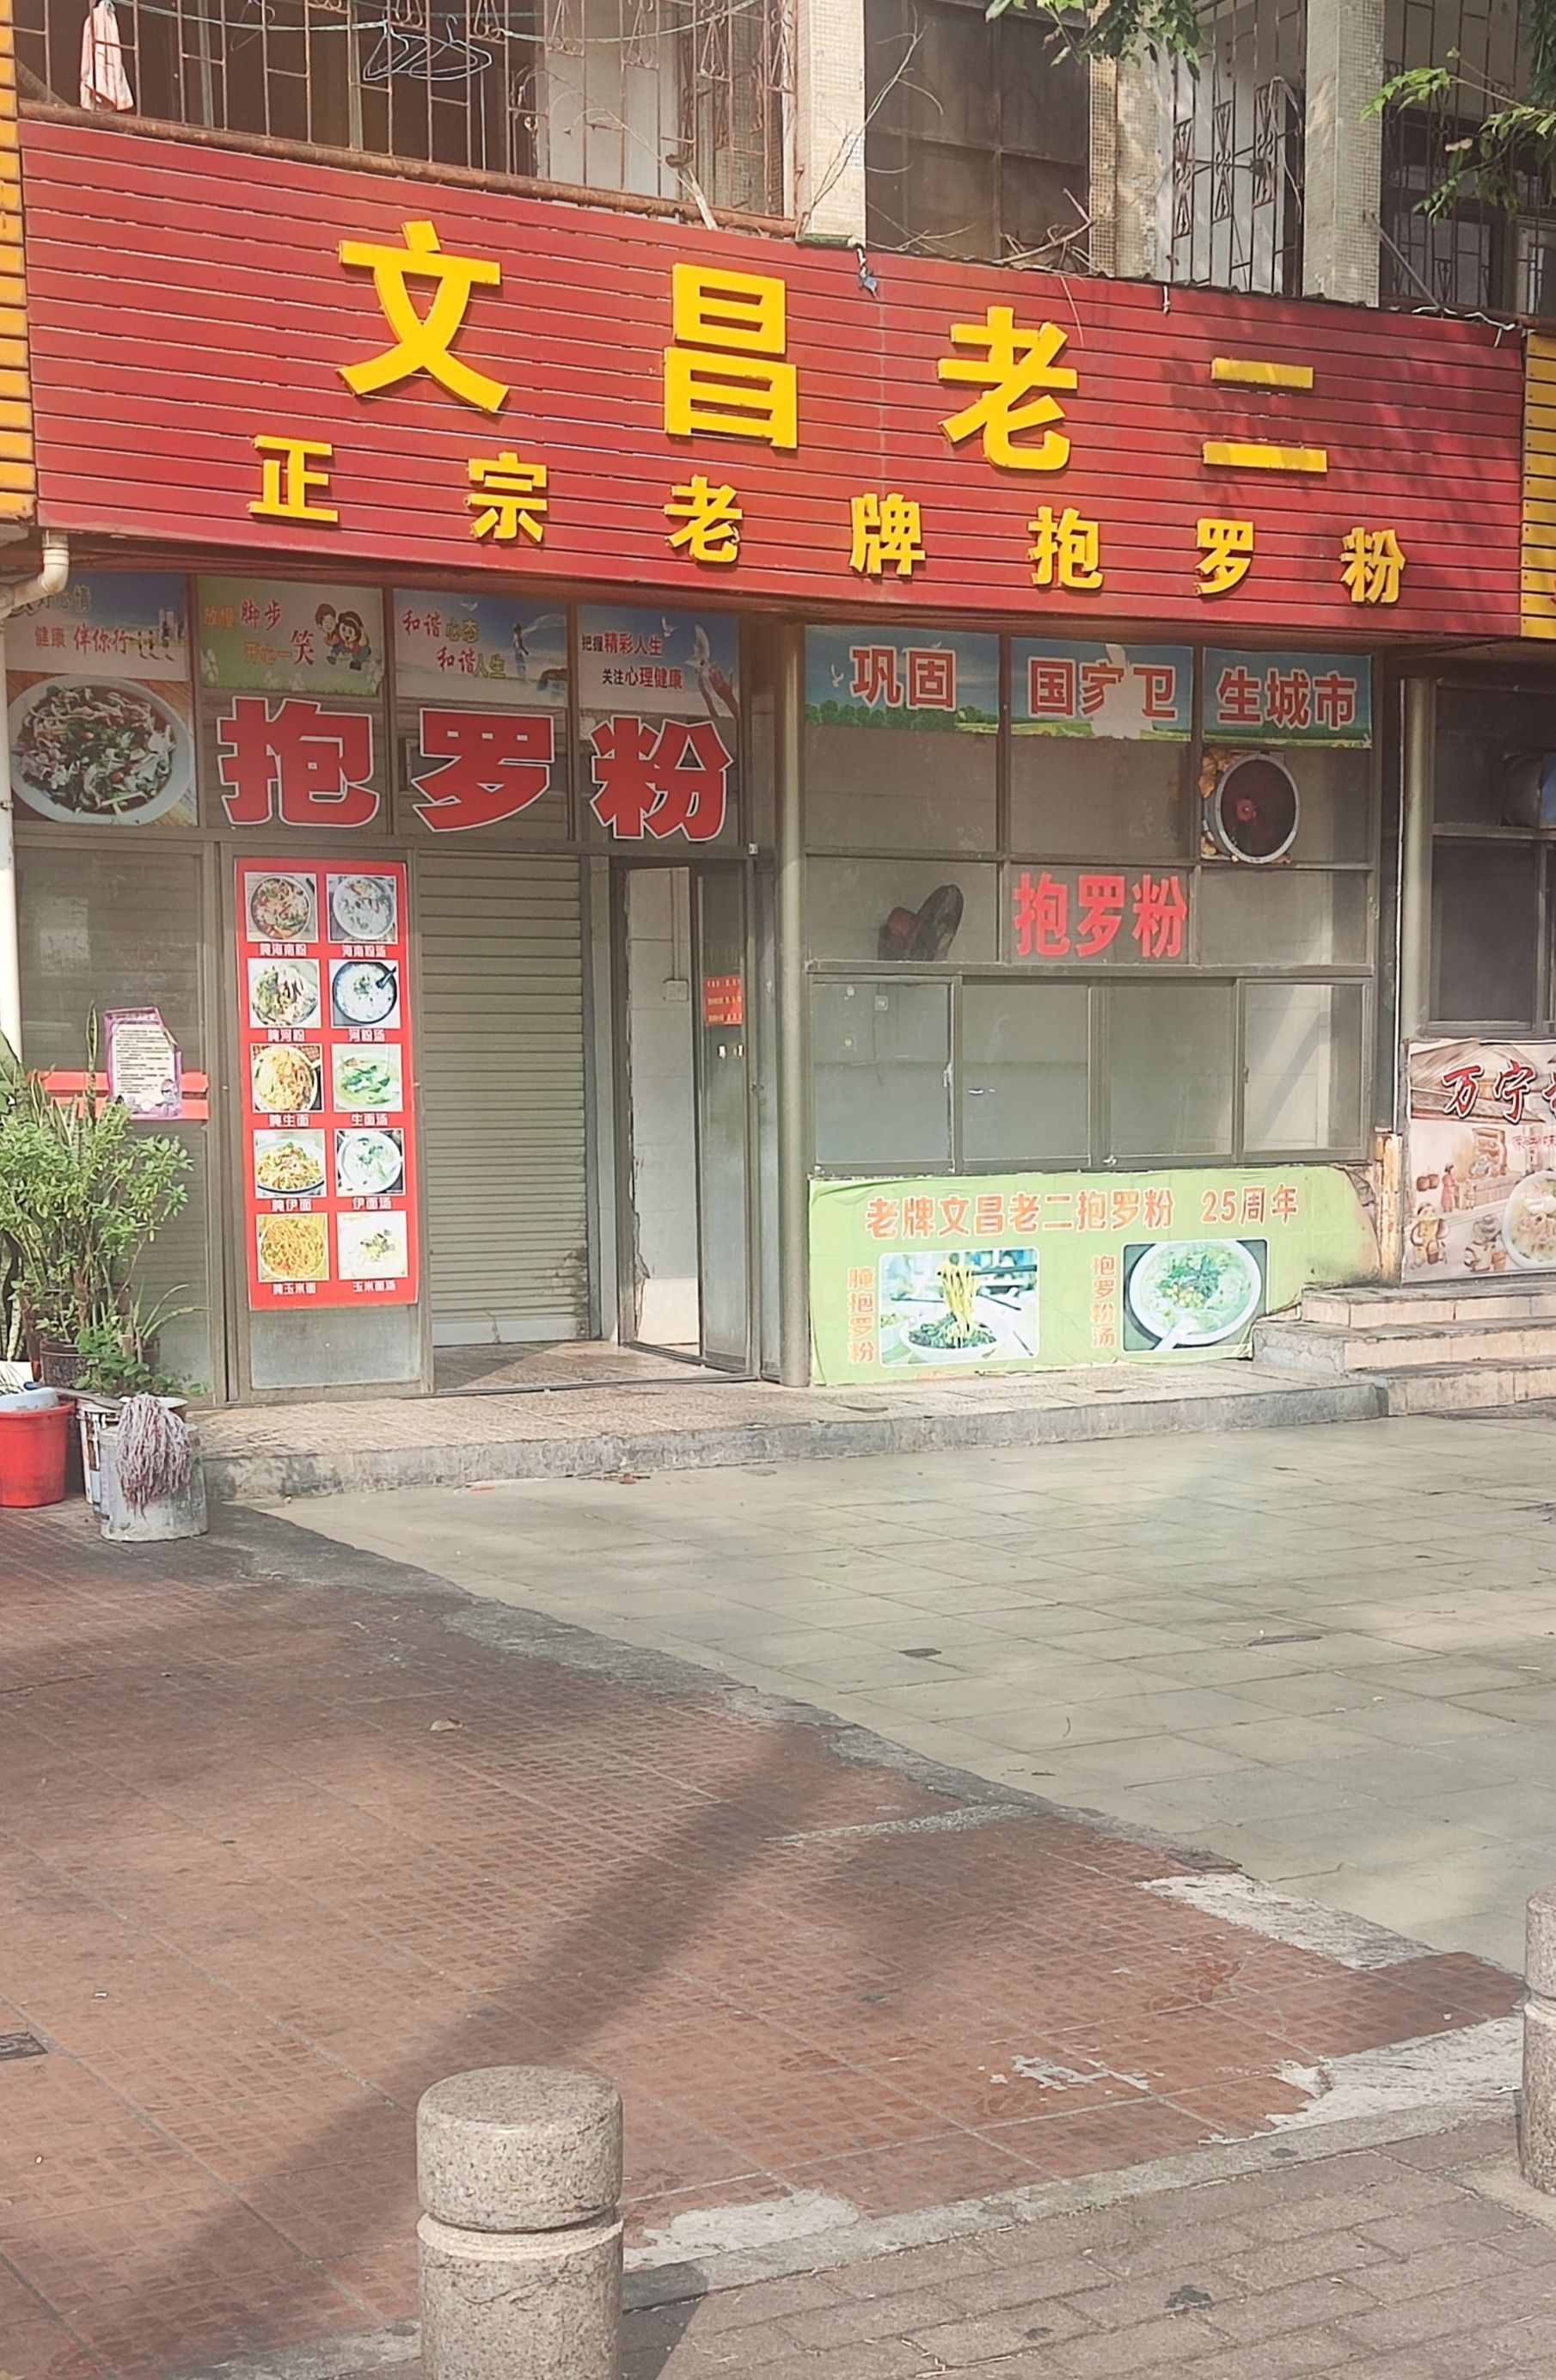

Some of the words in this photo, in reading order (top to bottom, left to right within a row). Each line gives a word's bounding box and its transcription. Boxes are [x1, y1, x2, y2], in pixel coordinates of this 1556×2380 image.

[336, 220, 1328, 471] 文昌老二
[248, 434, 1406, 604] 正宗老牌抱罗粉
[217, 696, 733, 842] 抱罗粉
[1013, 871, 1188, 960] 抱罗粉
[1442, 1059, 1556, 1125] 万宁
[865, 1187, 1176, 1240] 老牌文昌老二抱罗粉
[1201, 1183, 1299, 1226] 25周年
